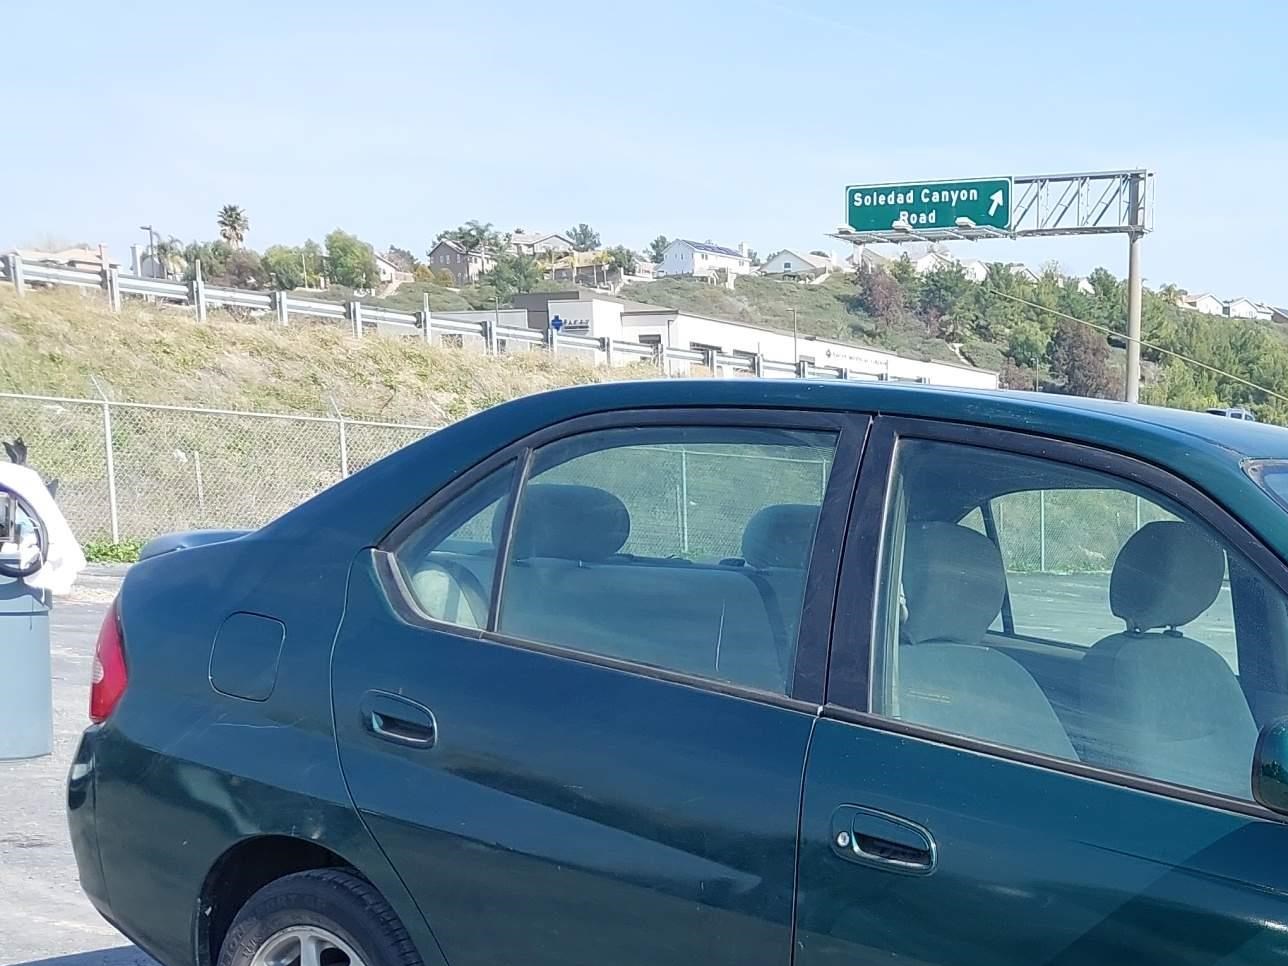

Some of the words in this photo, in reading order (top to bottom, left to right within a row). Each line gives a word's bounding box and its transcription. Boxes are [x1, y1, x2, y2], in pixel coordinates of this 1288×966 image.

[853, 189, 914, 207] Soledad
[920, 188, 978, 207] Canyon
[899, 209, 937, 224] Road
